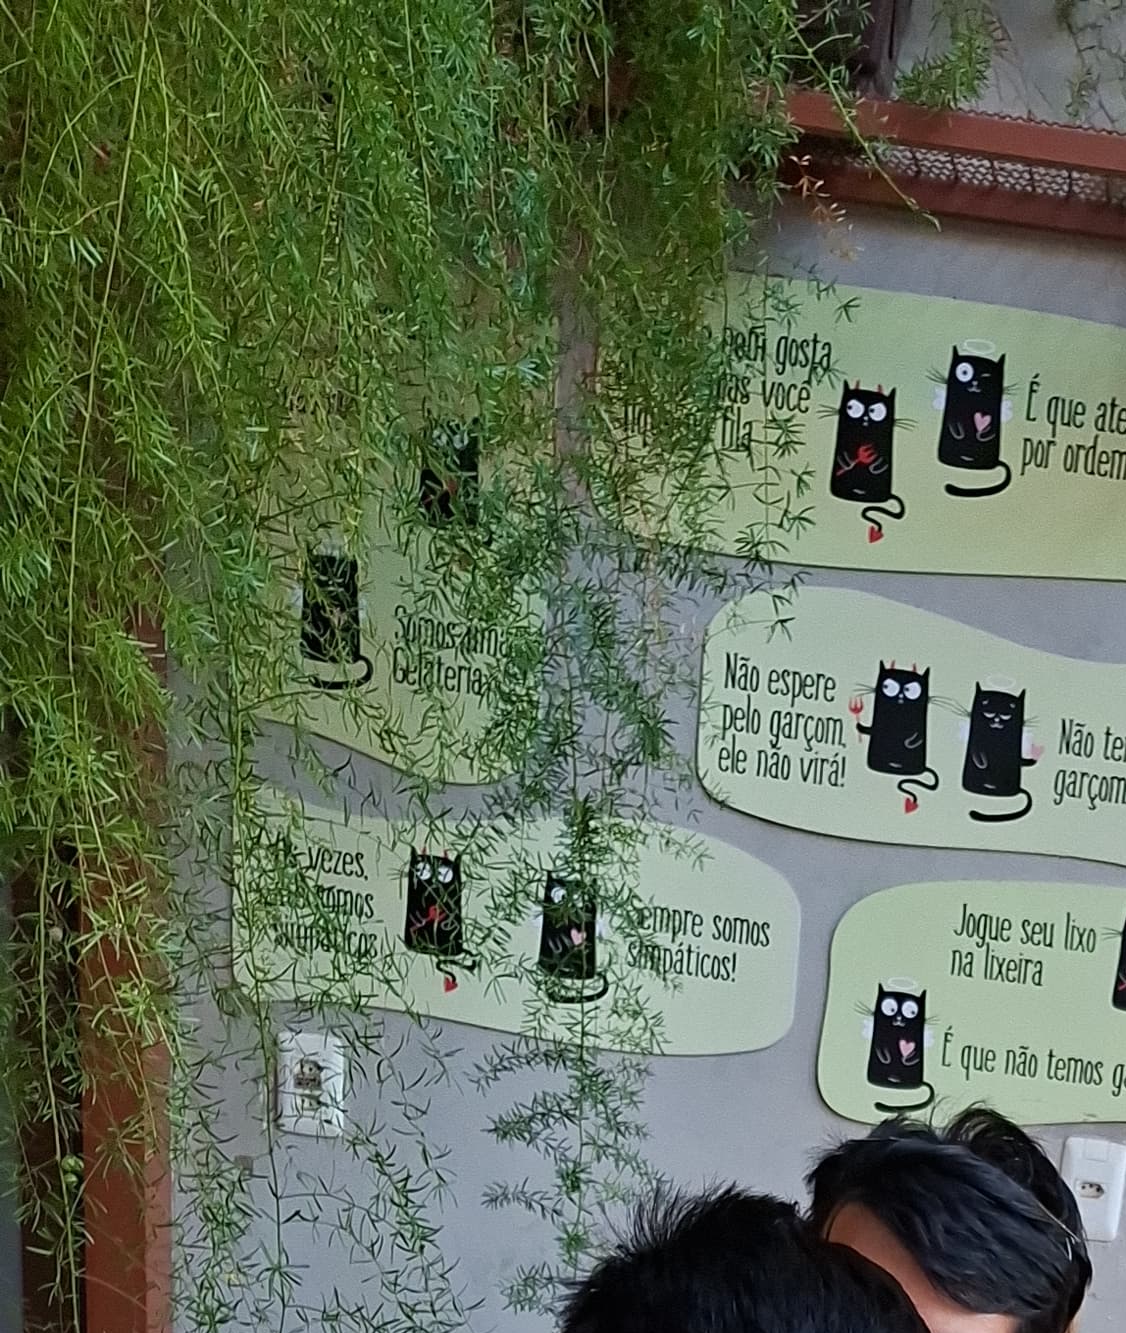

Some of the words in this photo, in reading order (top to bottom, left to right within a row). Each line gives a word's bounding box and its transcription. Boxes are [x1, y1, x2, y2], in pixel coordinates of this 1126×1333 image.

[1025, 373, 1041, 422] É
[1046, 396, 1087, 439] que
[1020, 438, 1057, 476] por
[723, 652, 760, 693] Não
[767, 668, 837, 708] espere
[720, 701, 762, 742] pelo
[1058, 718, 1095, 759] Não
[717, 734, 749, 774] ele
[756, 744, 792, 782] não
[799, 750, 847, 788] virá!
[712, 913, 771, 948] somos
[953, 903, 1012, 949] Jogue
[1020, 918, 1055, 948] seu
[1064, 912, 1097, 954] lixo
[950, 949, 974, 979] na
[983, 943, 1044, 987] lixeira
[941, 1025, 954, 1068] É
[961, 1043, 997, 1082] que
[1005, 1046, 1038, 1079] não
[1046, 1048, 1105, 1088] temos
